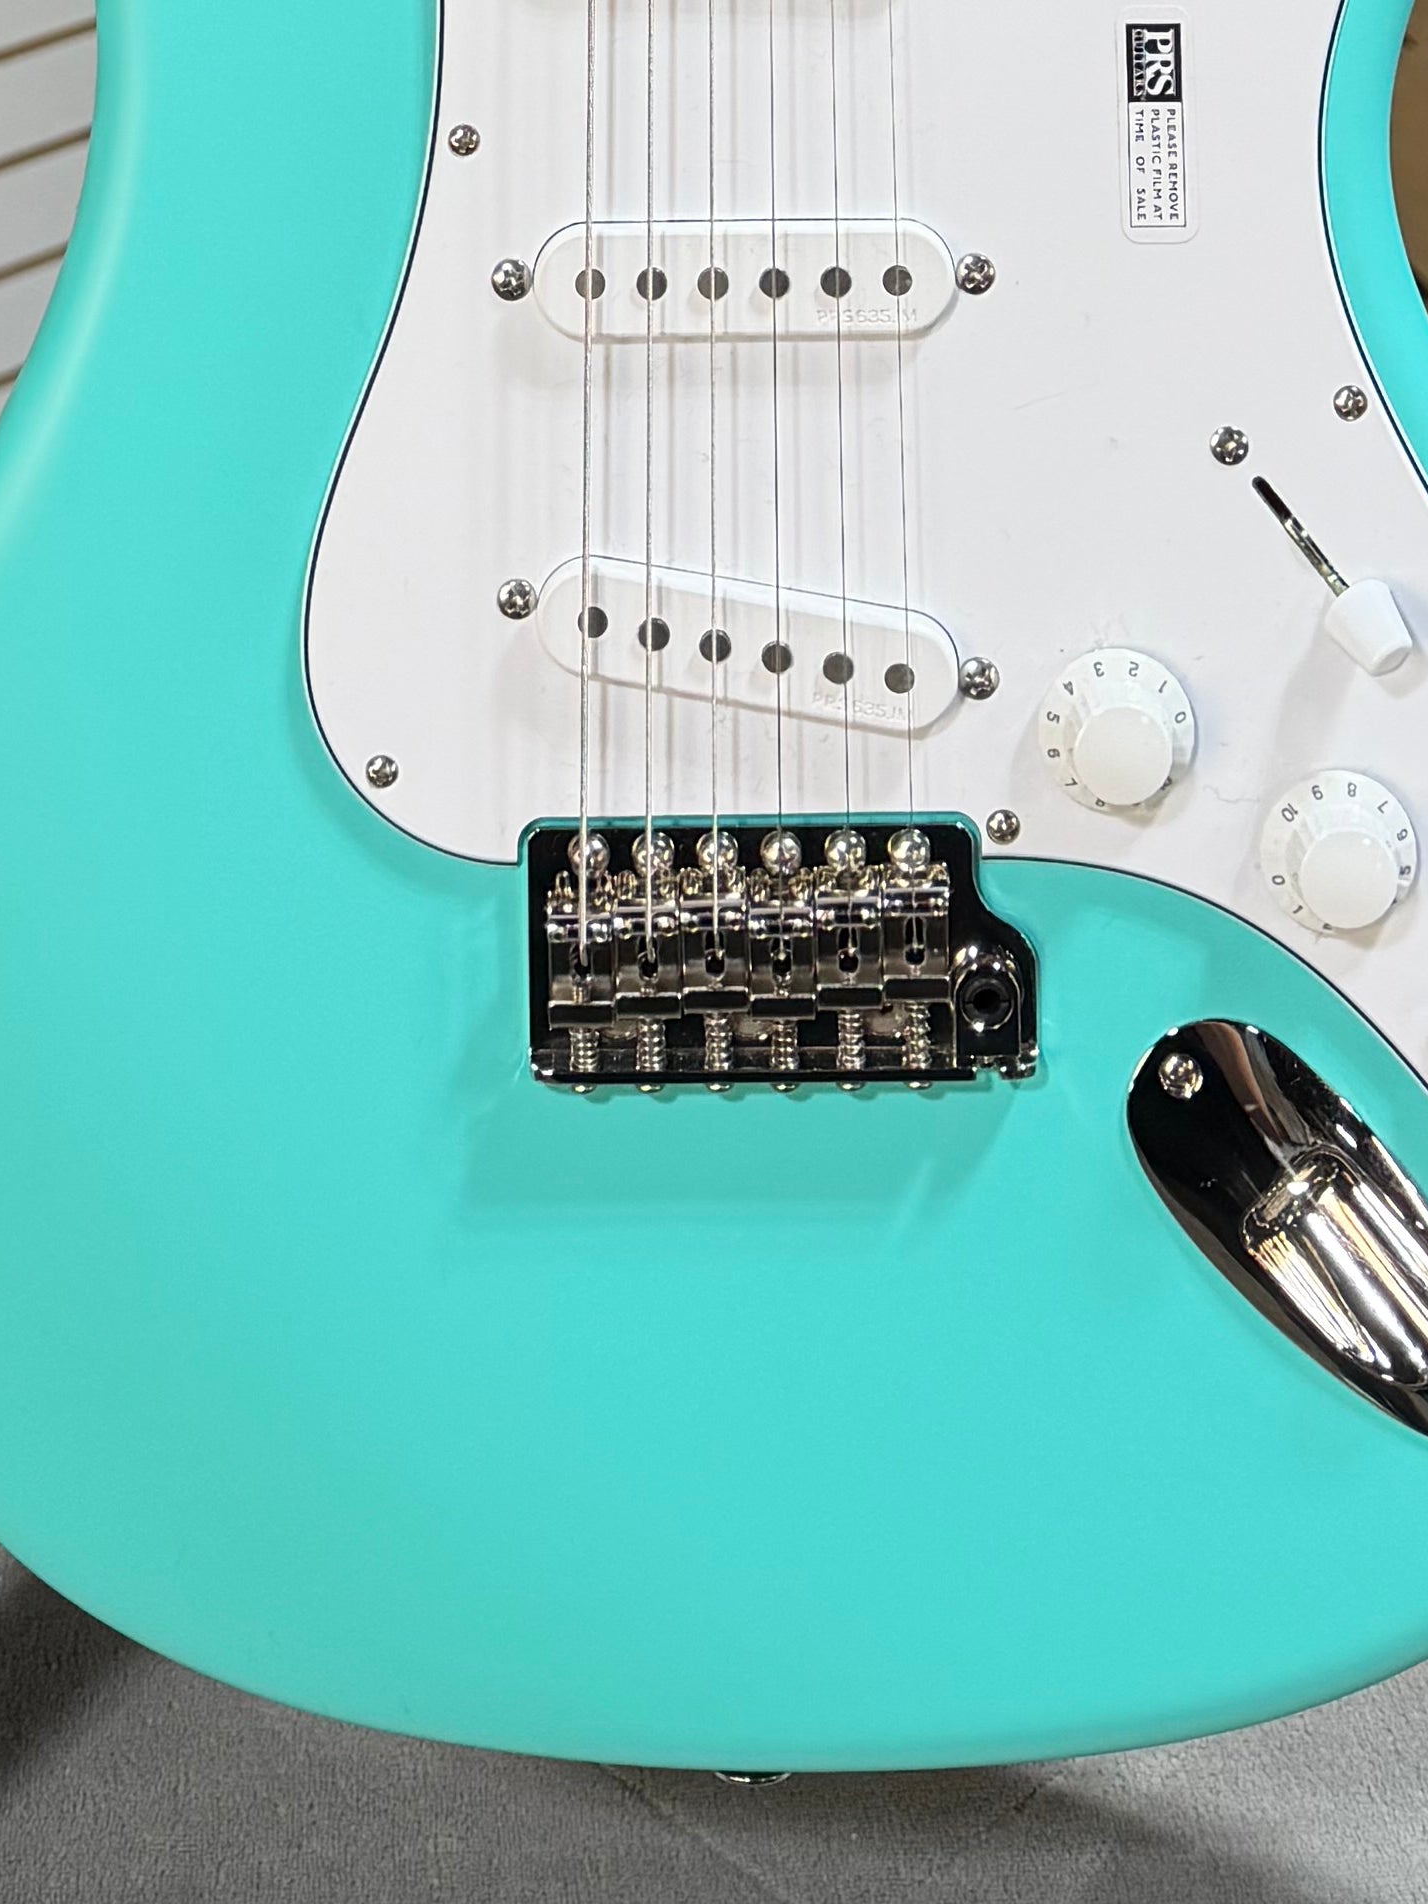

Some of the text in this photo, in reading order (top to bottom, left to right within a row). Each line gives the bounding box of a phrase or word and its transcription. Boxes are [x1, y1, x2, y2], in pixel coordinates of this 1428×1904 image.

[1143, 28, 1175, 96] PRS
[1134, 109, 1147, 221] TIME OF SALE
[1150, 108, 1164, 222] PLASTIC FILM AT
[1166, 108, 1180, 221] PLEASE REMOVE
[1062, 680, 1075, 697] 4
[1092, 661, 1105, 678] 3
[1127, 661, 1140, 678] 2
[1045, 710, 1061, 725] 5
[1280, 802, 1299, 823] 10
[1311, 784, 1324, 801] 9
[1347, 782, 1358, 798] 8
[1376, 800, 1389, 814] 7
